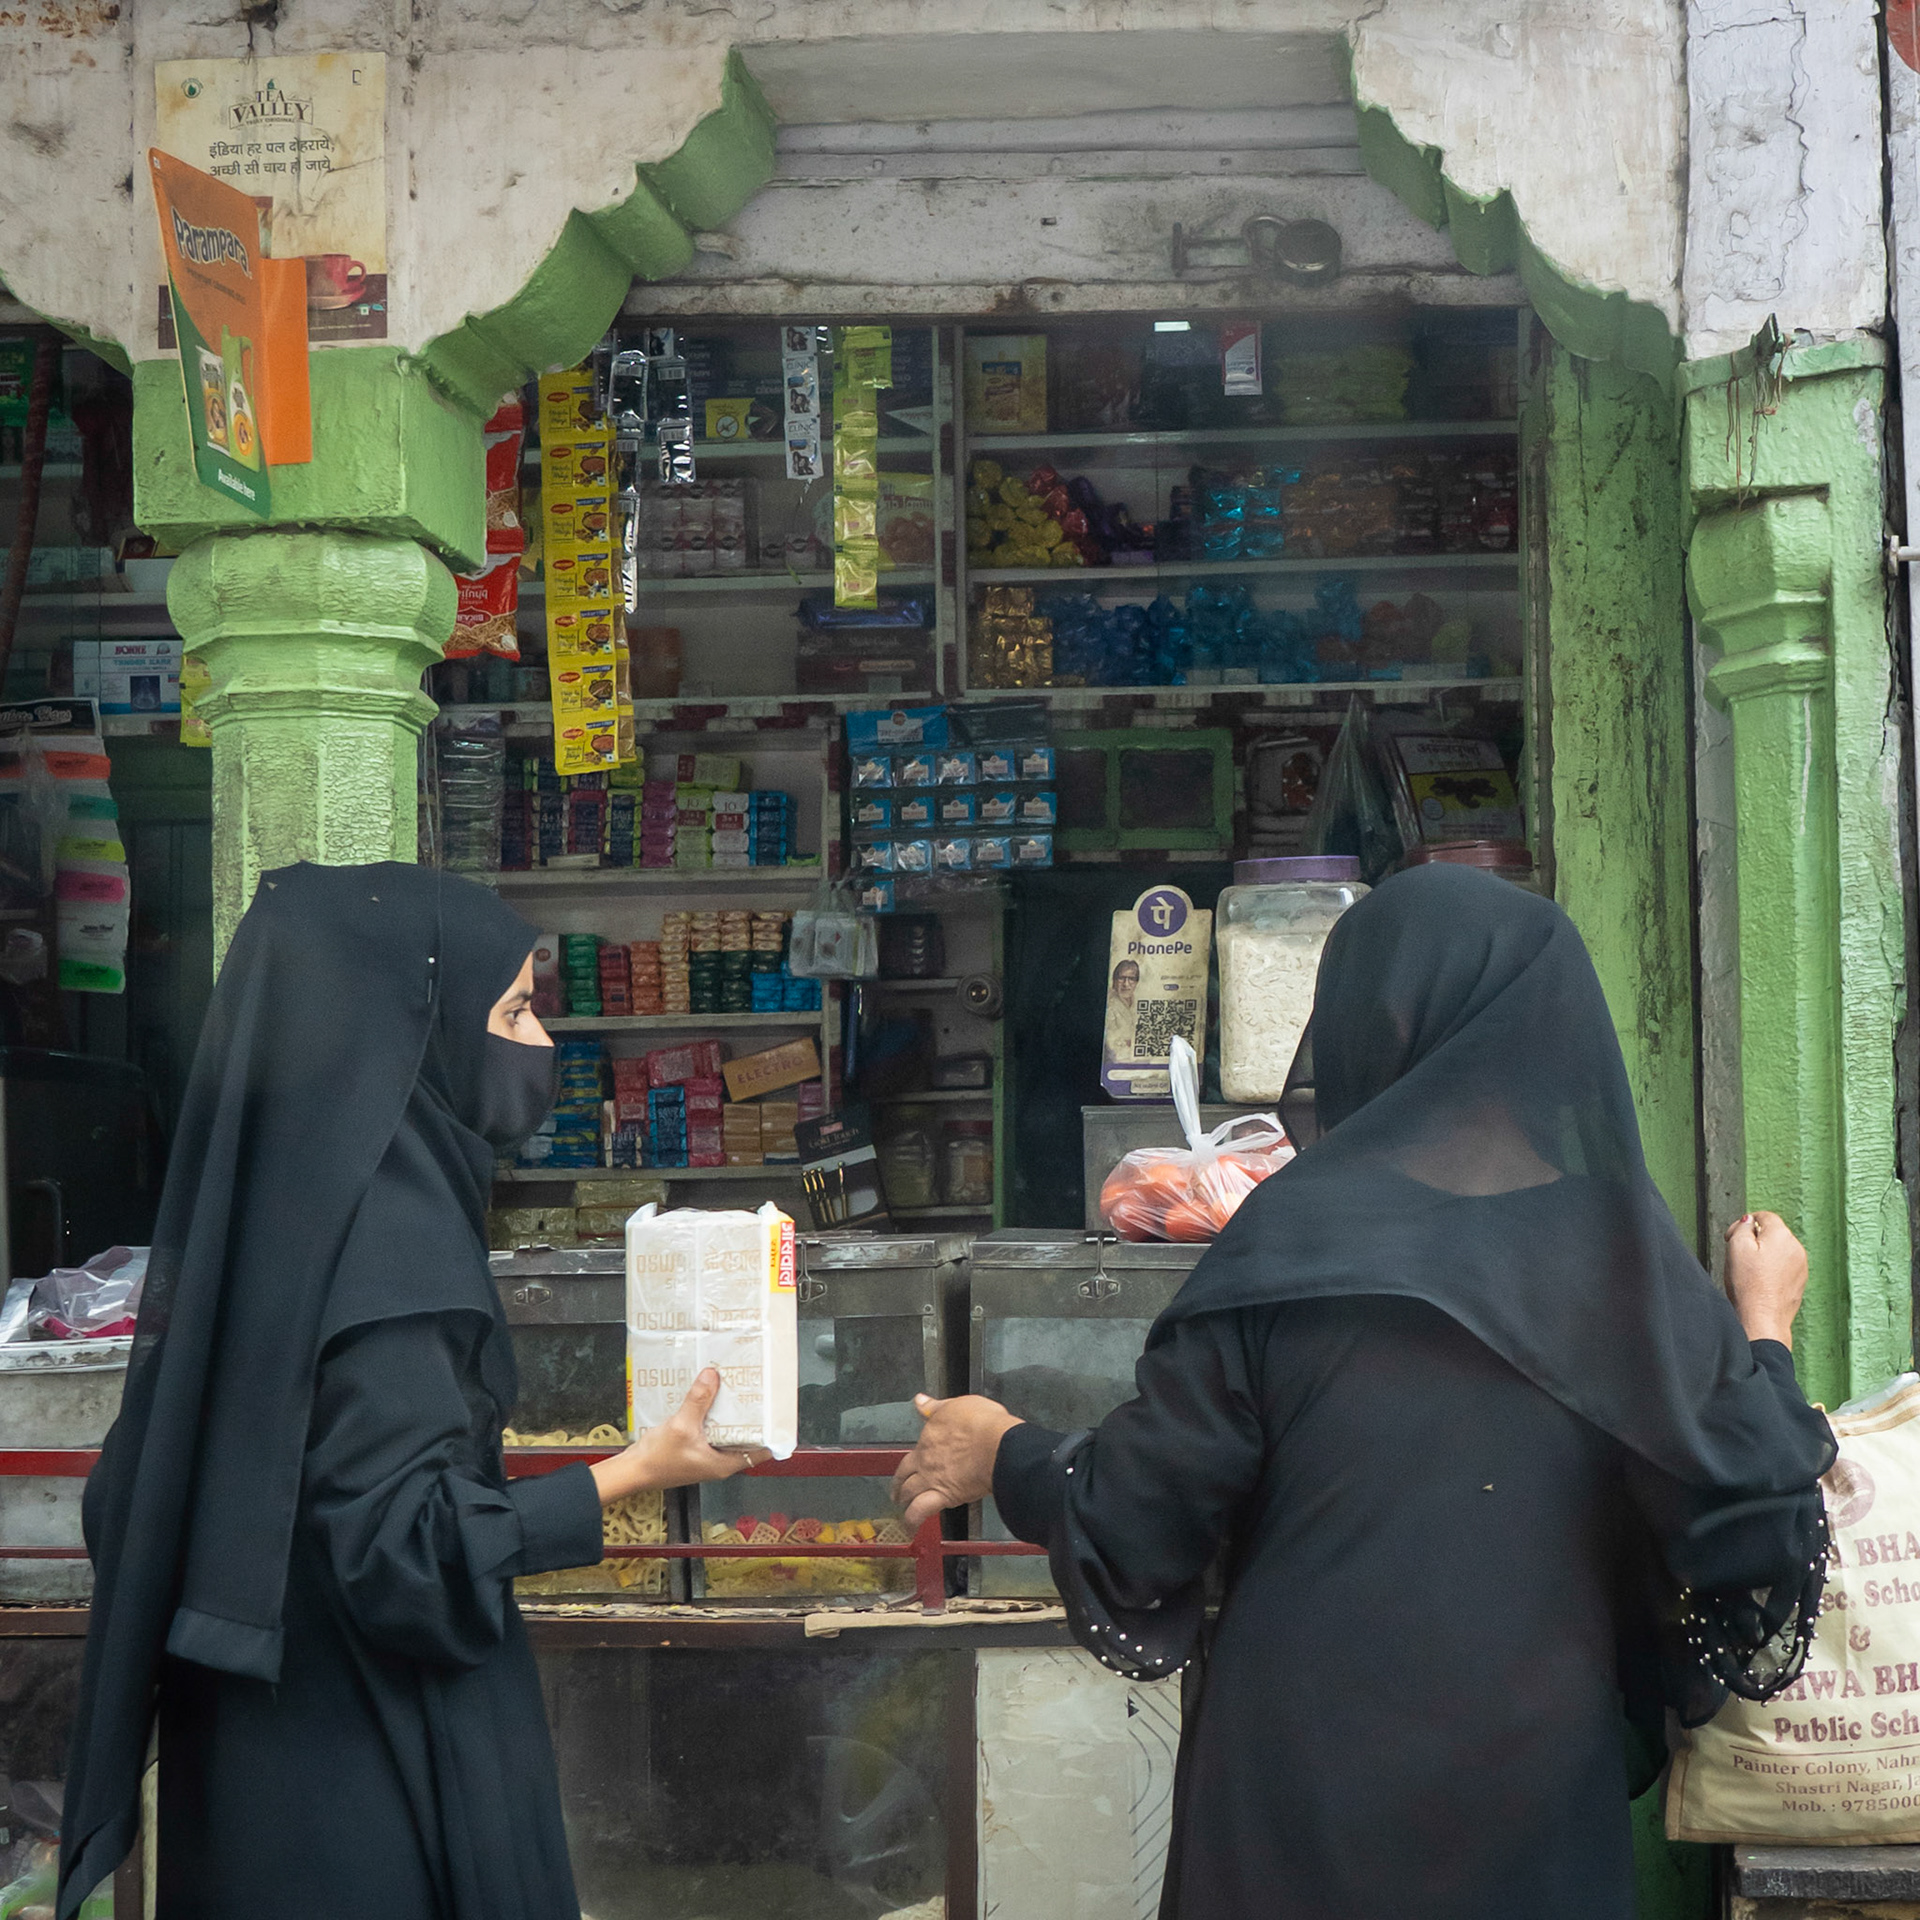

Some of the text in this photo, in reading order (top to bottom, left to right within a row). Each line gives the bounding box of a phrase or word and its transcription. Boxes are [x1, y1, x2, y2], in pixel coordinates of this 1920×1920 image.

[255, 89, 285, 103] TEA
[232, 102, 310, 123] VALLEY
[209, 141, 243, 158] इंडिया
[246, 143, 262, 156] हर
[266, 142, 285, 153] पल
[209, 160, 241, 176] अच्छी
[244, 159, 259, 175] सी
[263, 162, 286, 174] चाय
[290, 157, 301, 174] हो
[171, 205, 250, 278] Parampara
[1150, 896, 1174, 930] पे
[1128, 941, 1192, 955] PhonePe
[737, 1056, 804, 1084] ELECTRO
[1848, 1624, 1872, 1652] &
[1774, 1715, 1862, 1743] Public
[1733, 1754, 1801, 1775] Painter
[1804, 1761, 1871, 1776] Colony,
[1775, 1781, 1841, 1794] Shastri
[1846, 1779, 1903, 1795] Nagar,
[1781, 1800, 1826, 1813] Mob.
